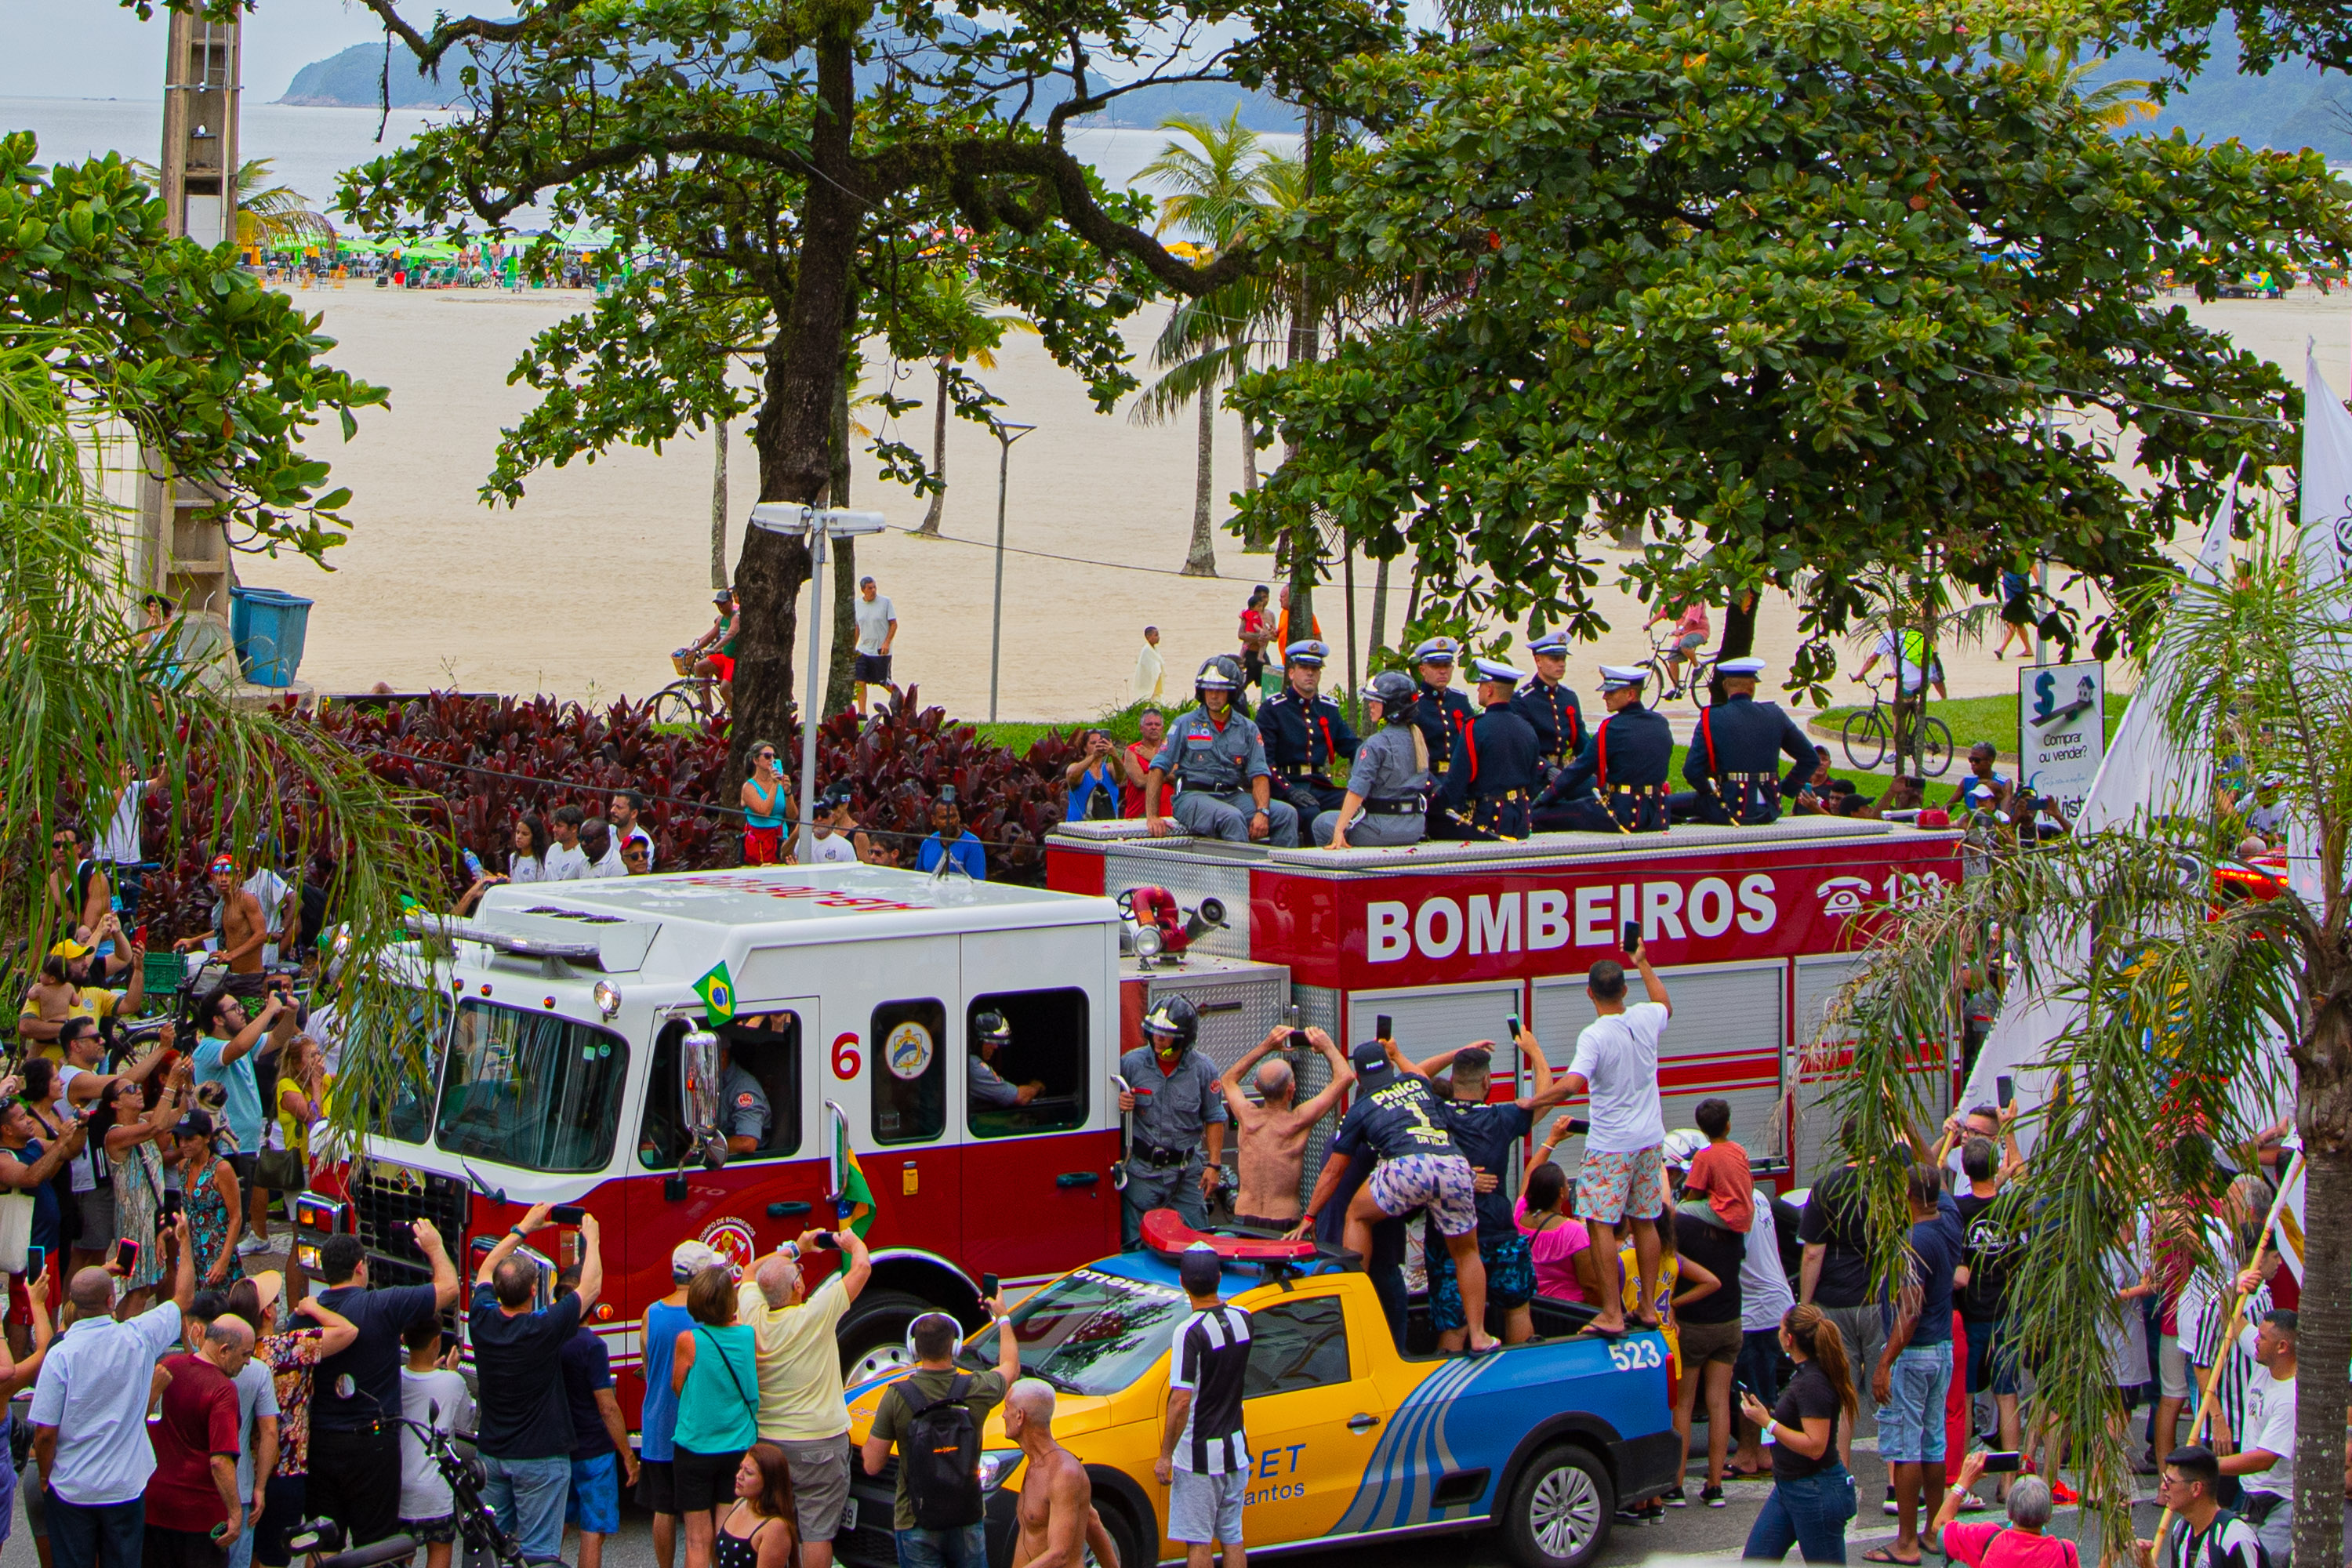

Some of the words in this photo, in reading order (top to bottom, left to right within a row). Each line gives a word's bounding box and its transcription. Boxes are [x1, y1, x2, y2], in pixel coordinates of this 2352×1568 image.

[2043, 732, 2082, 746] Comprar
[2038, 753, 2050, 764] ou
[2053, 745, 2088, 762] vender?
[1367, 873, 1777, 964] BOMBEIROS
[1883, 871, 1941, 910] 193
[831, 1031, 862, 1080] 6
[1370, 1080, 1422, 1105] Philco
[698, 1221, 717, 1242] CORPO
[716, 1217, 725, 1225] DE
[1608, 1339, 1661, 1371] 523
[1243, 1483, 1305, 1507] antos
